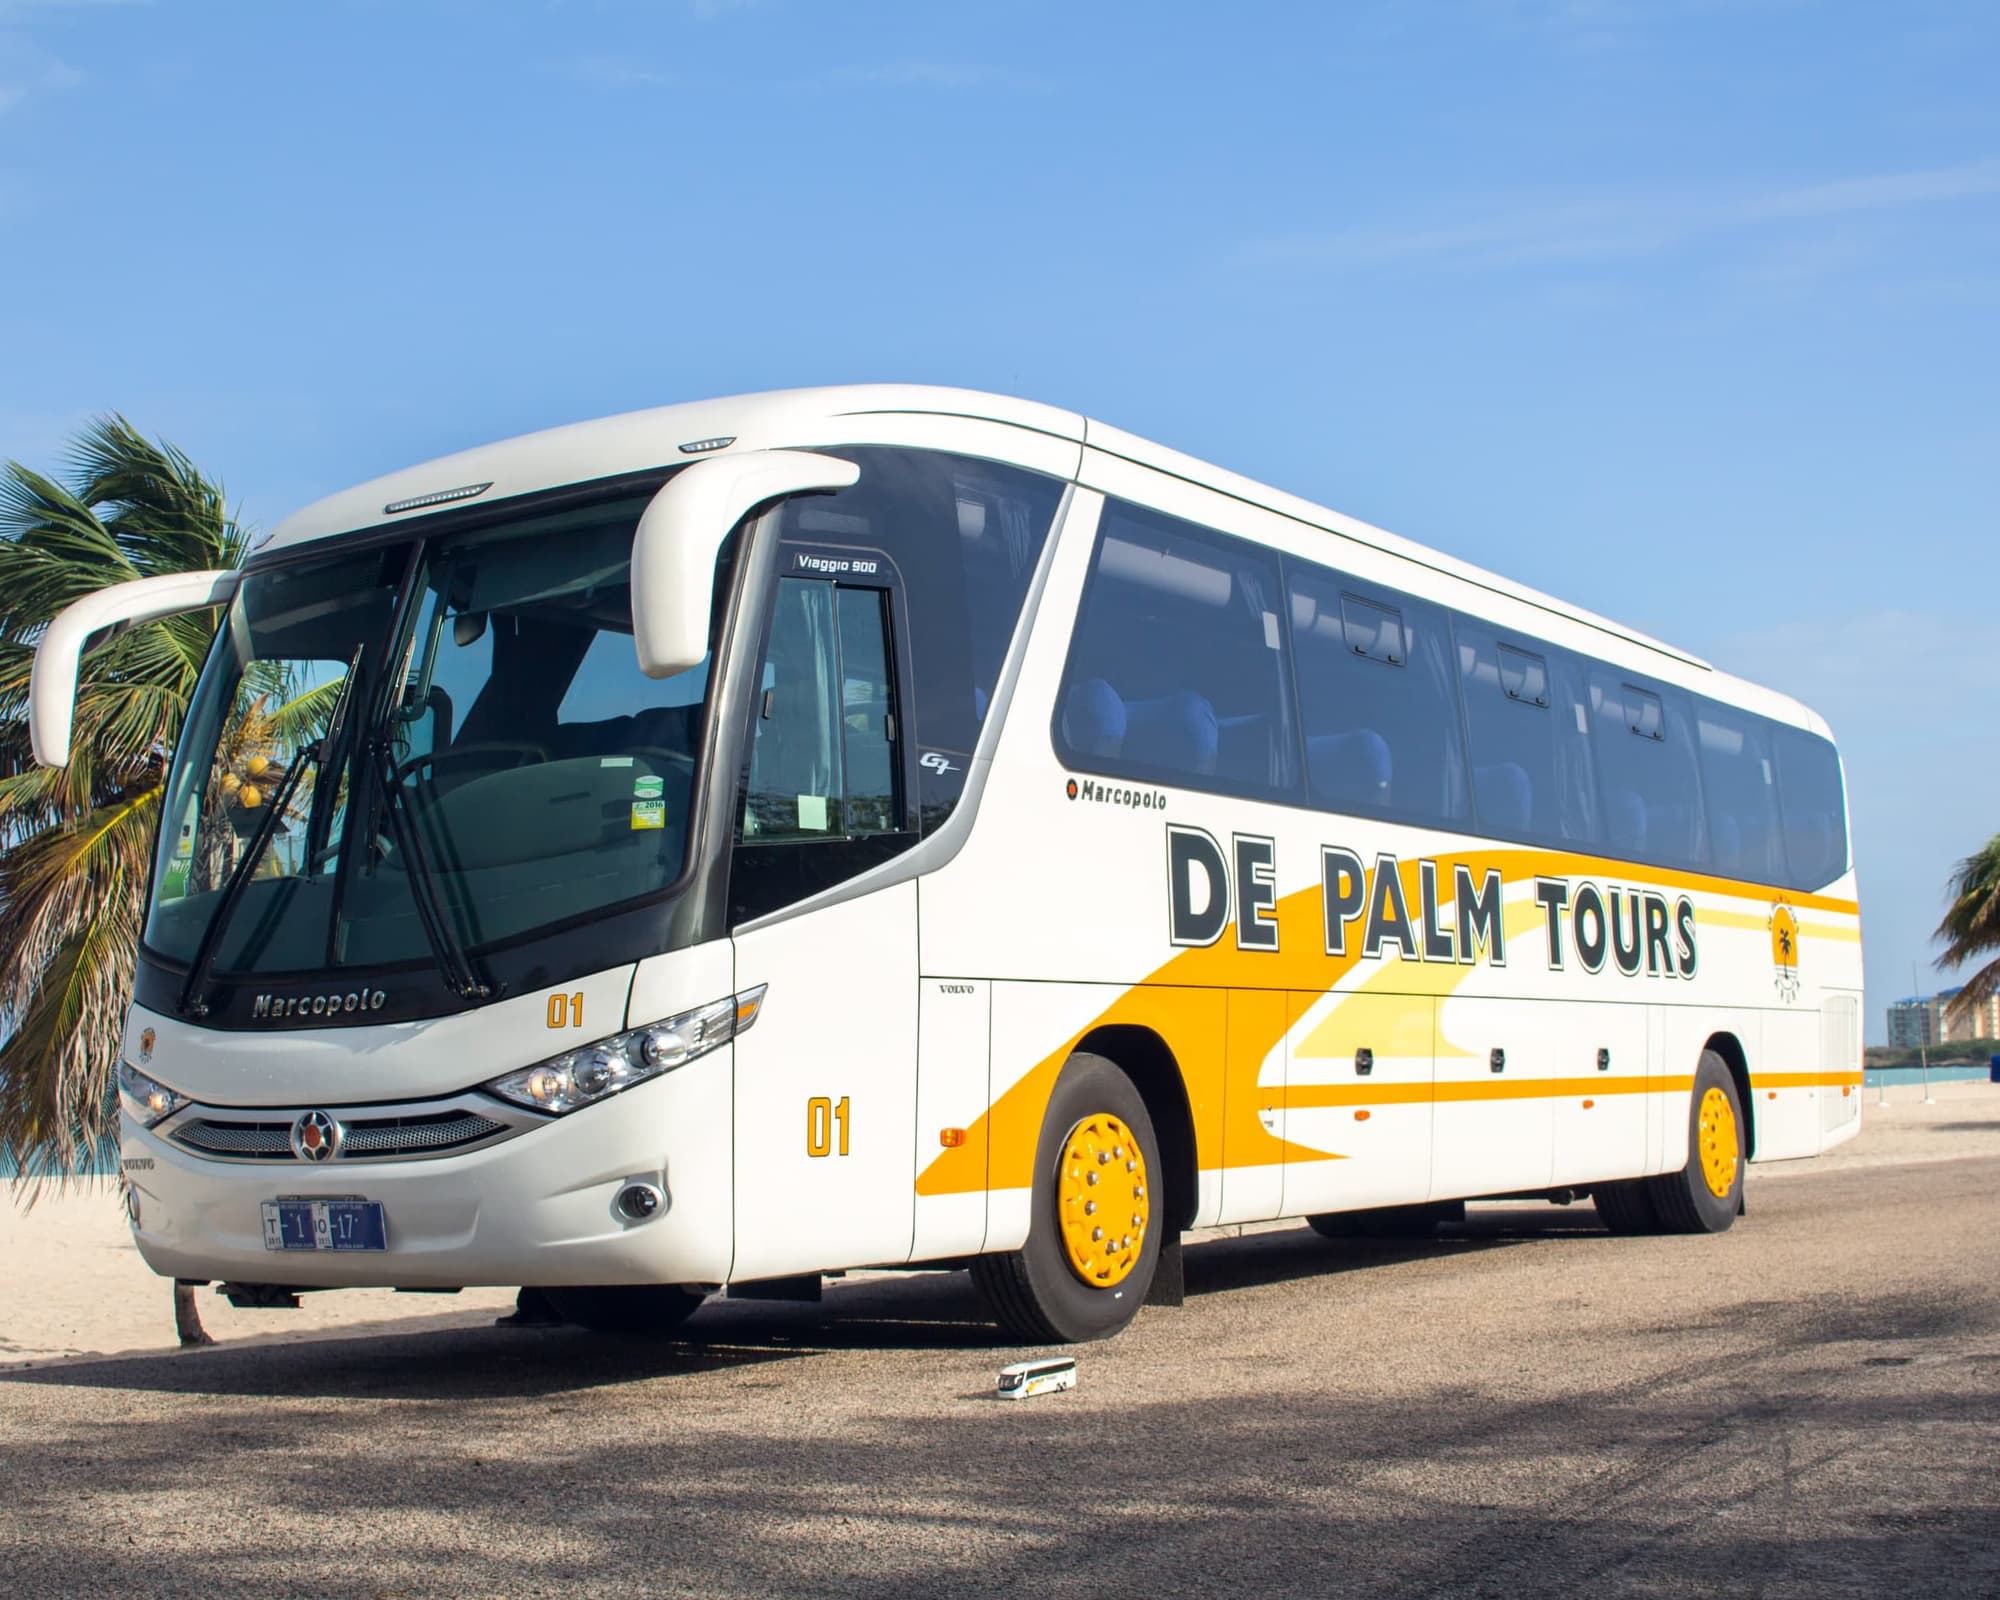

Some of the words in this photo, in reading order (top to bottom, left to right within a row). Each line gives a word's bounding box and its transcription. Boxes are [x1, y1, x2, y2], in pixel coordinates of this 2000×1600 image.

[798, 555, 849, 573] Viaggio
[852, 561, 877, 573] 900
[1081, 780, 1167, 810] Marcopolo
[1165, 822, 1281, 953] DE
[1320, 844, 1507, 969] PALM
[1534, 875, 1698, 981] TOURS
[252, 988, 387, 1018] Marcopolo
[939, 984, 975, 994] VOLVO
[546, 991, 584, 1029] 01
[807, 1096, 850, 1157] 01
